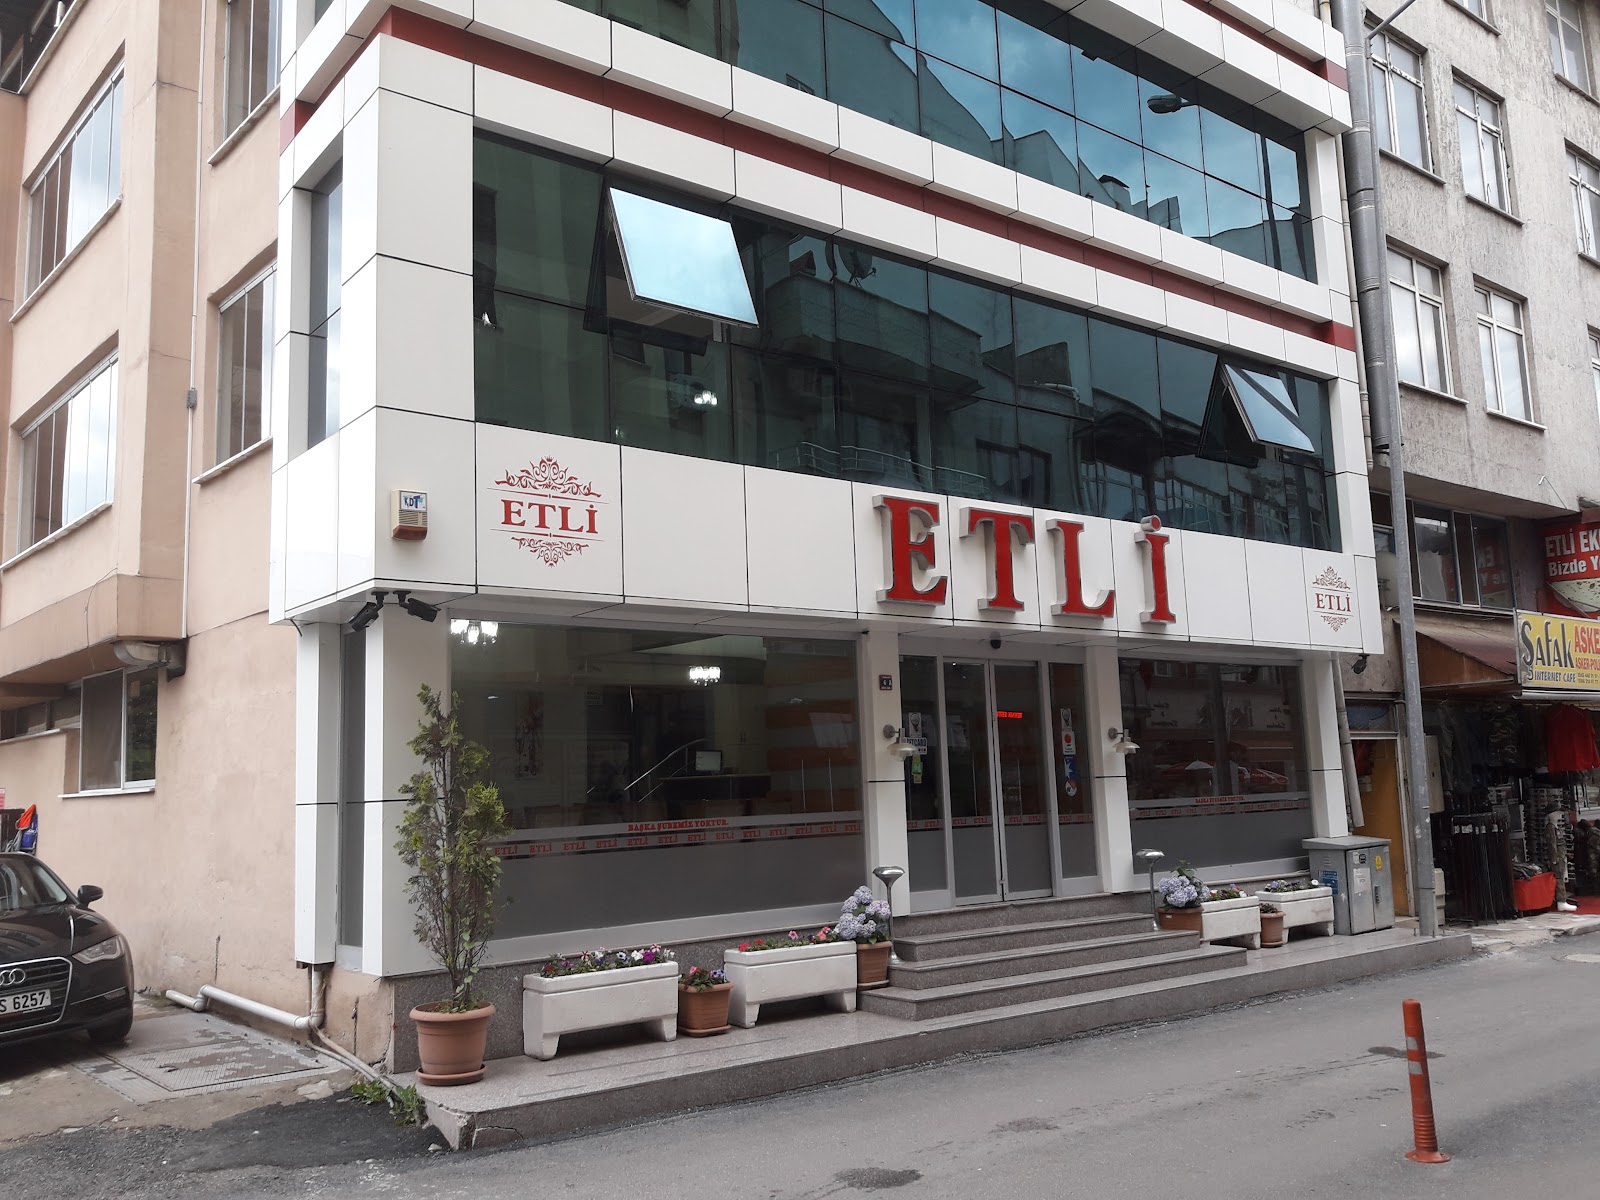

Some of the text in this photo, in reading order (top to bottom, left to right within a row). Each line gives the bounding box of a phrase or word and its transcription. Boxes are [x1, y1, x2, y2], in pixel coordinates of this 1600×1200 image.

[501, 499, 599, 534] ETLİ
[1544, 528, 1600, 558] ETLİ EK
[872, 494, 1177, 625] ETLİ
[1547, 559, 1587, 577] Bizde
[1315, 593, 1352, 613] ETLİ
[1564, 673, 1576, 683] CAFE
[628, 823, 656, 832] BAŞKA
[13, 991, 46, 1010] 6257
